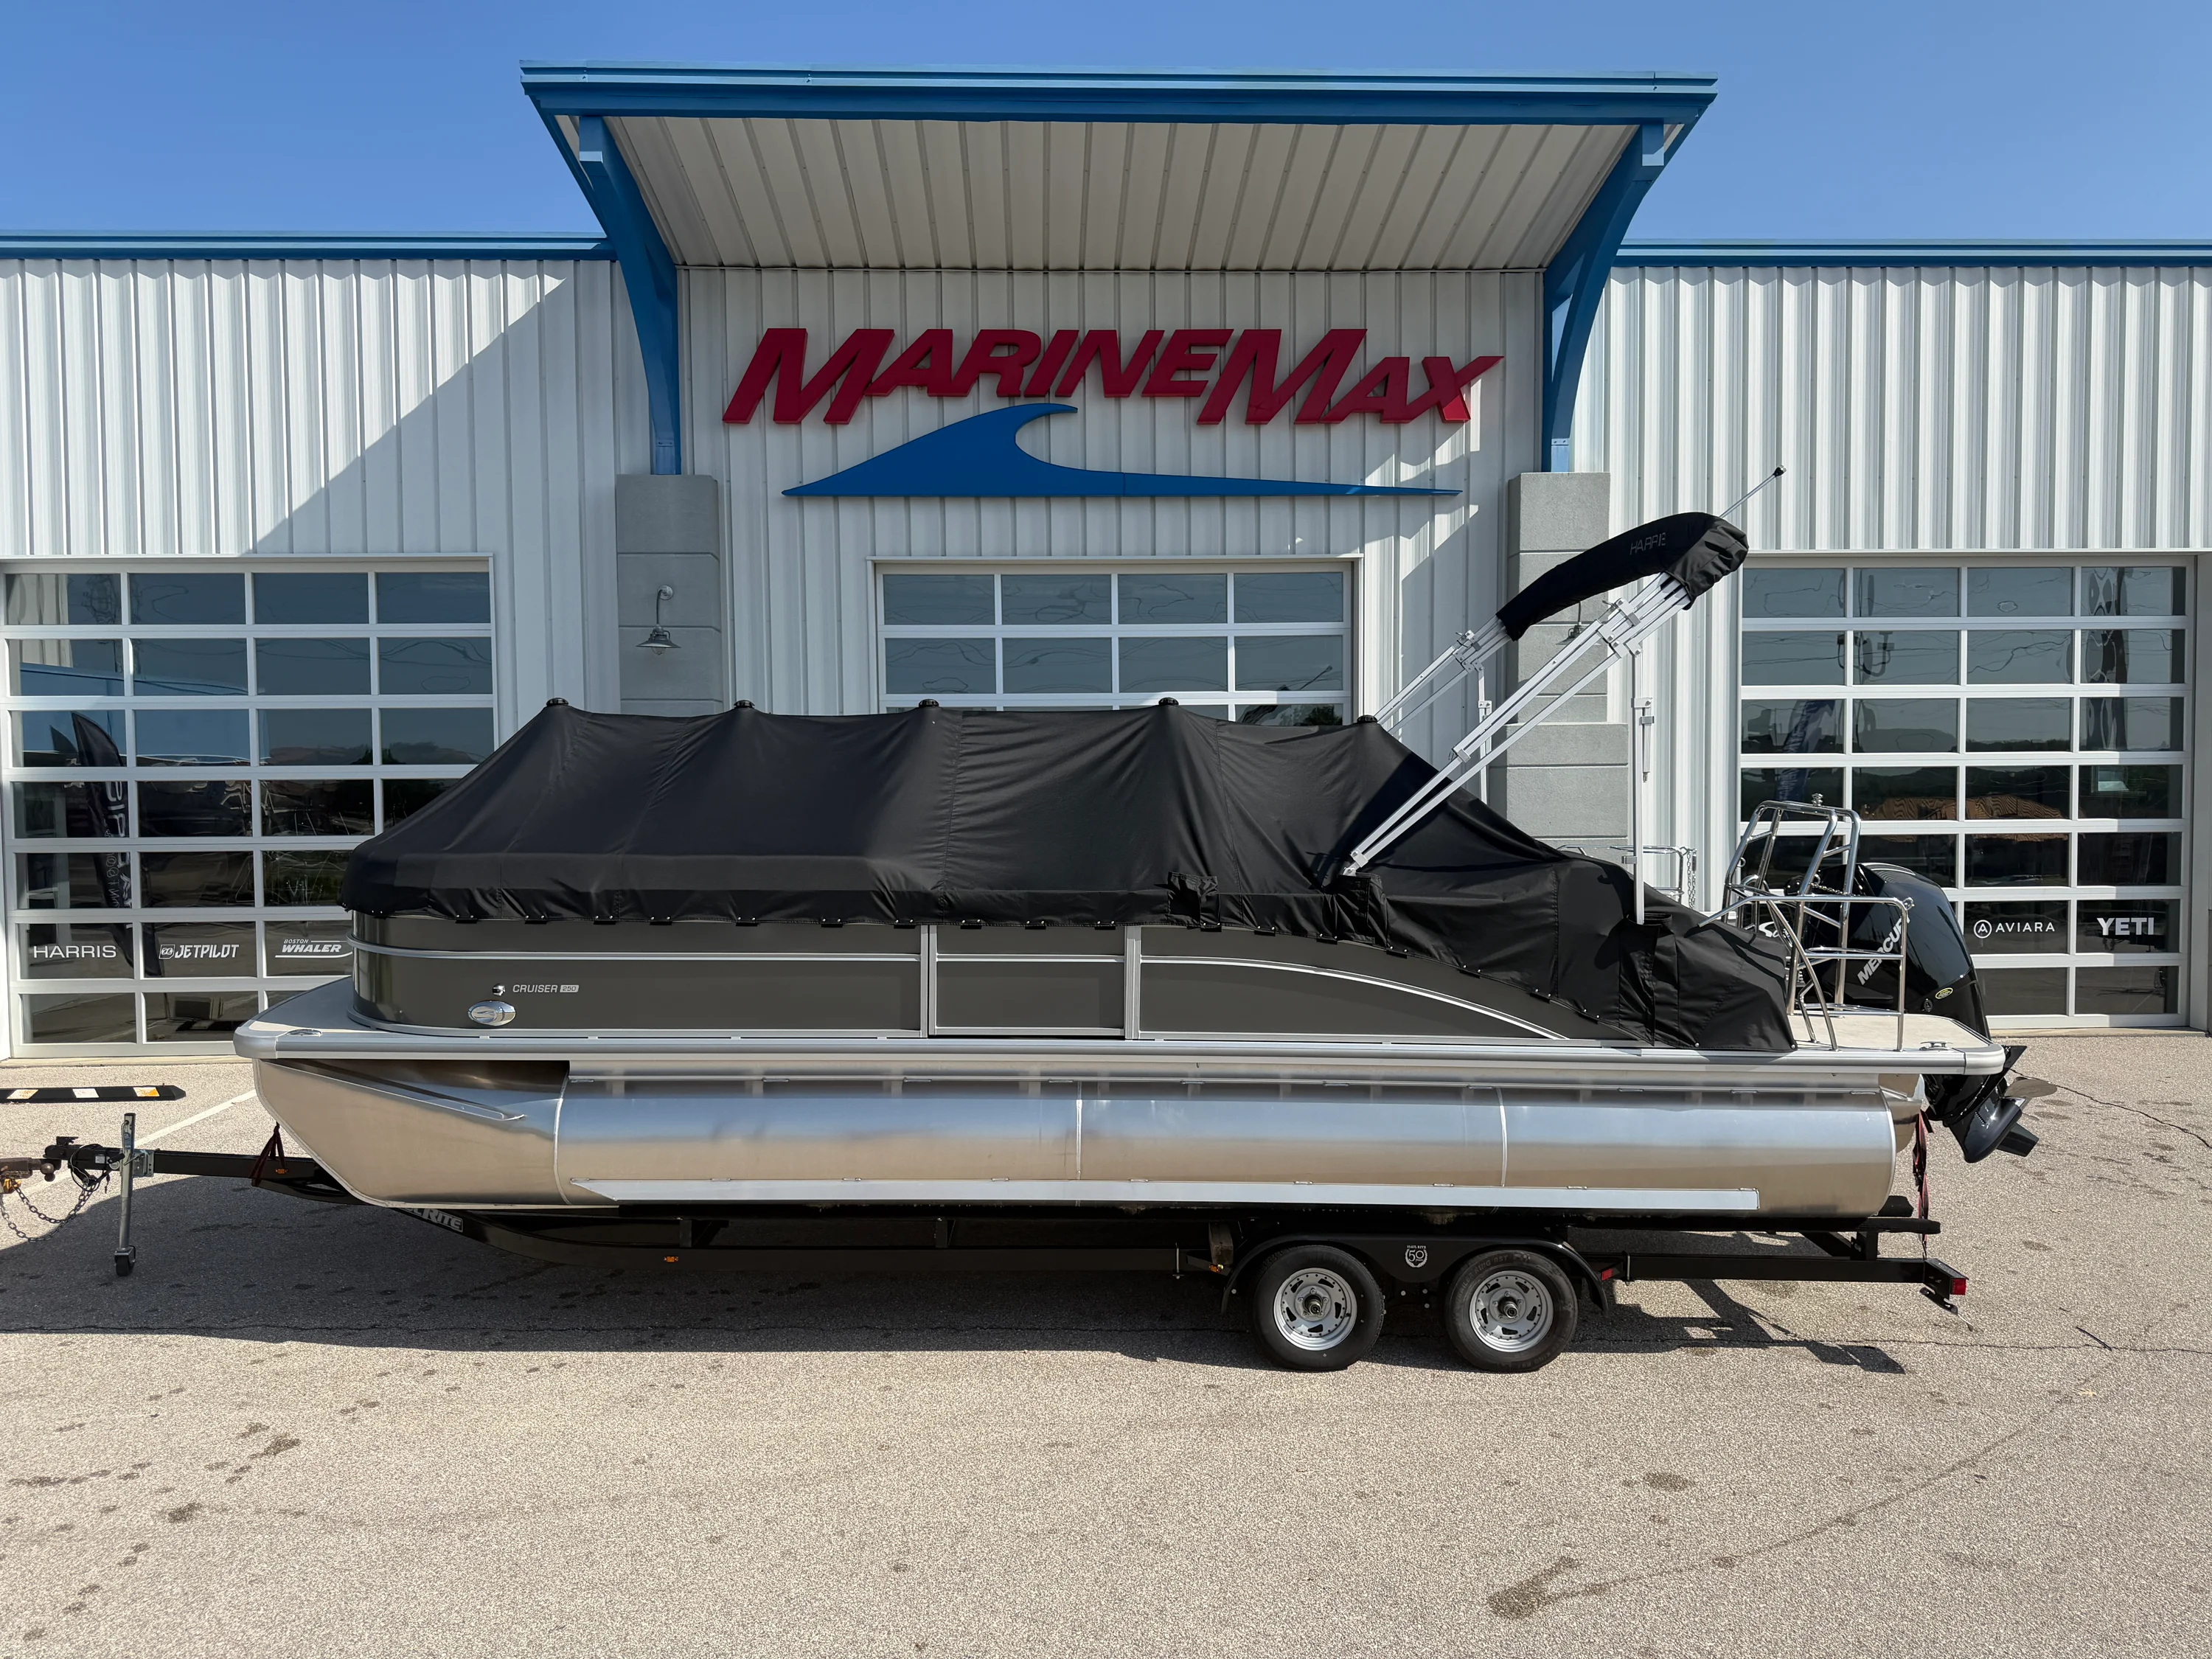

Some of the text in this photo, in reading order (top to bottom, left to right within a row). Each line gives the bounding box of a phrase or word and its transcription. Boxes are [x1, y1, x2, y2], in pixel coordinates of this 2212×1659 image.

[723, 328, 1504, 425] MARINEMAX
[1995, 922, 2056, 933] AVIARA
[2097, 917, 2154, 936] YETI
[33, 945, 116, 959] HARRIS
[174, 945, 240, 959] JETPILOT
[282, 944, 342, 953] WHALER
[512, 984, 558, 993] CRUISER
[1408, 1250, 1425, 1262] 50
